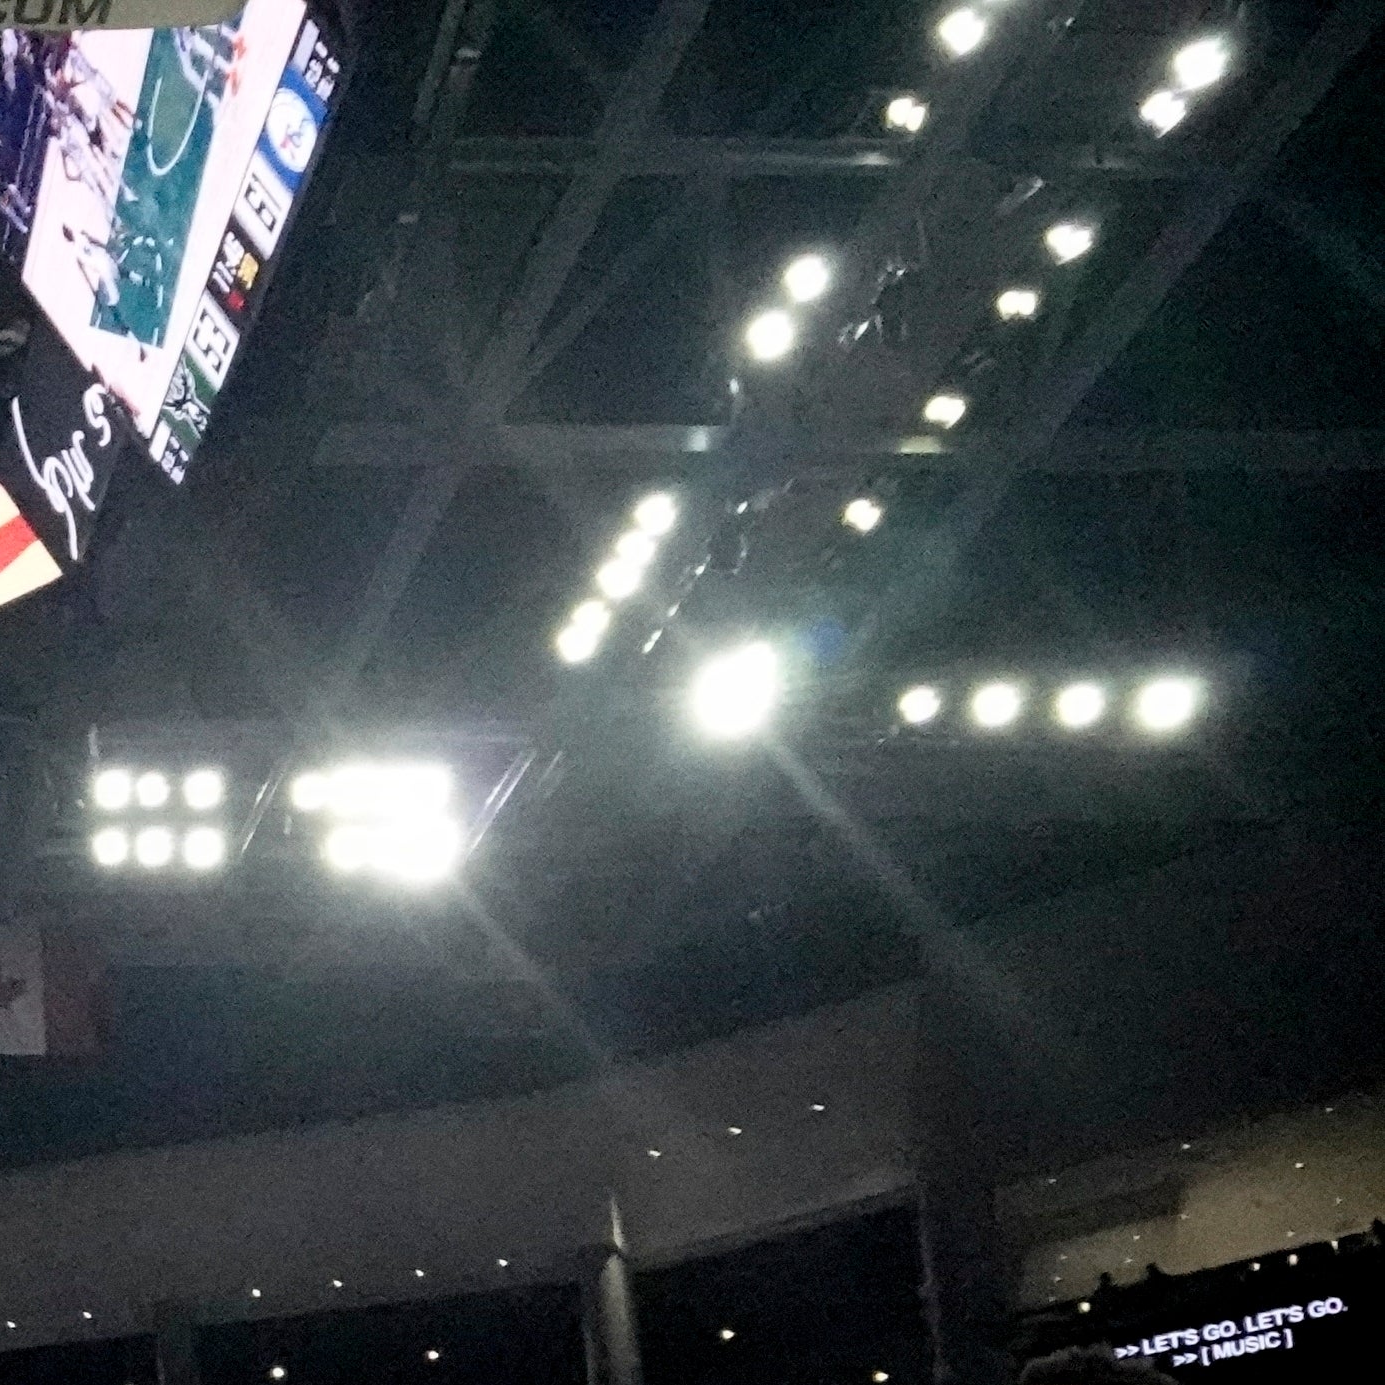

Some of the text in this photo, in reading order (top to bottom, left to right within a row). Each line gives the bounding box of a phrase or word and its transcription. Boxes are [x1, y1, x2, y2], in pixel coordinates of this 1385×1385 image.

[1141, 1327, 1201, 1356] LET'S
[1202, 1320, 1242, 1341] GO.
[1244, 1304, 1305, 1333] LET'S
[1308, 1297, 1349, 1318] GO.
[1212, 1331, 1282, 1361] MUSIC
